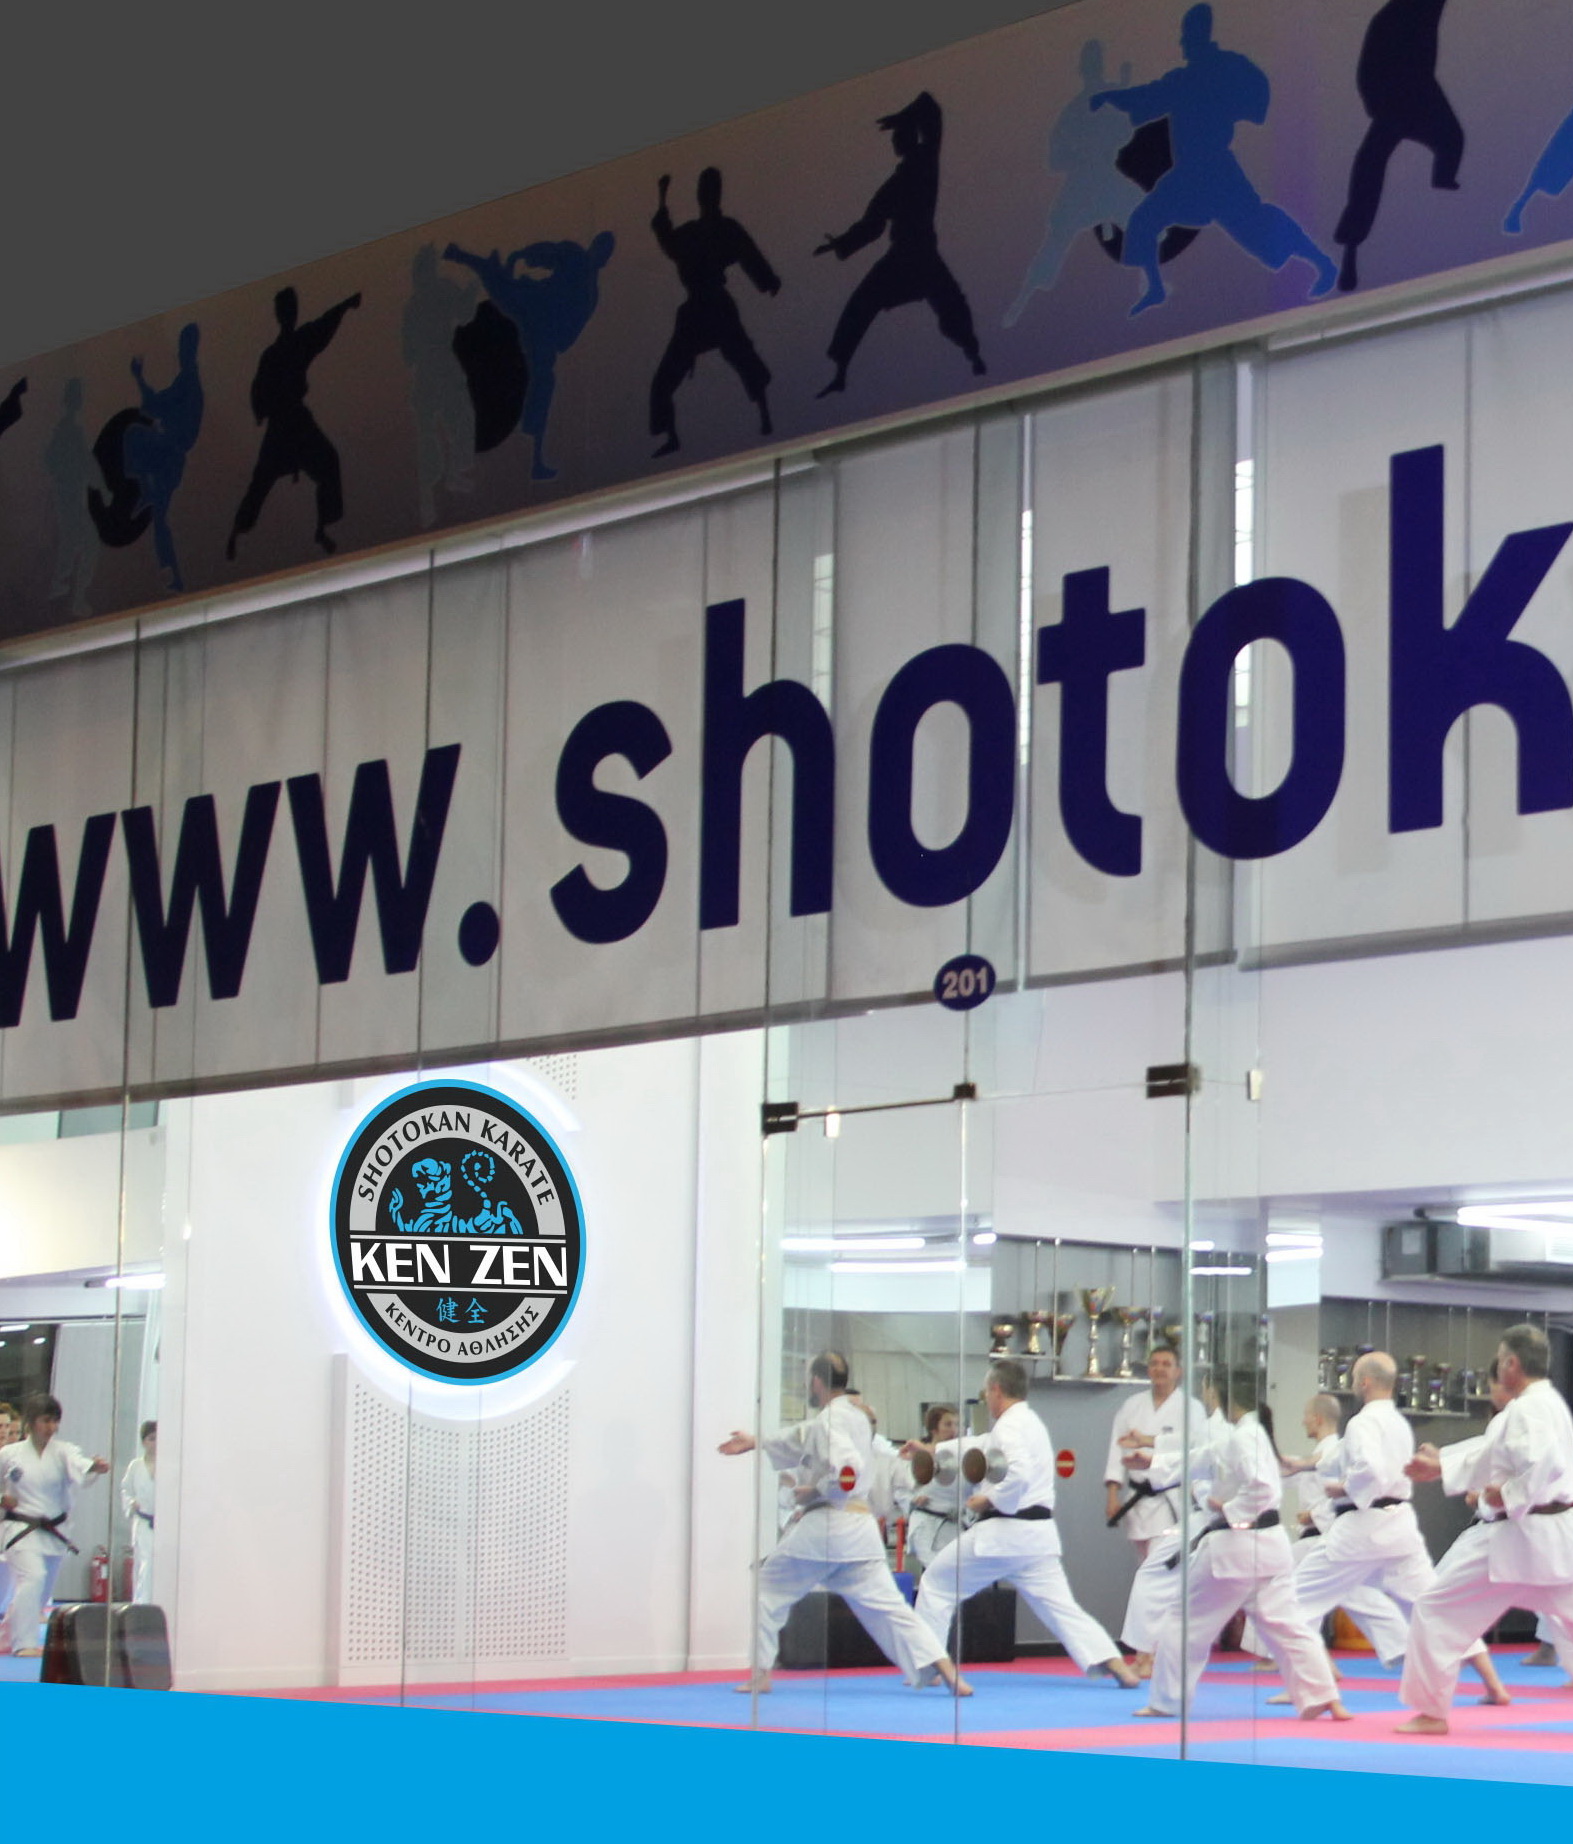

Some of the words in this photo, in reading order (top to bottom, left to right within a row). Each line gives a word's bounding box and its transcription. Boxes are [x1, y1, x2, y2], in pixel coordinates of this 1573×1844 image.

[941, 966, 988, 1000] 201
[358, 1111, 471, 1202] SHOTOKAN
[481, 1119, 555, 1206] KARATE
[350, 1242, 450, 1284] KEN
[469, 1244, 567, 1287] ZEN
[385, 1302, 450, 1353] ΚΕΝΤΡΟ
[457, 1305, 539, 1356] ΑΘΛΗΣΗΣ
[436, 1297, 488, 1324] 健全
